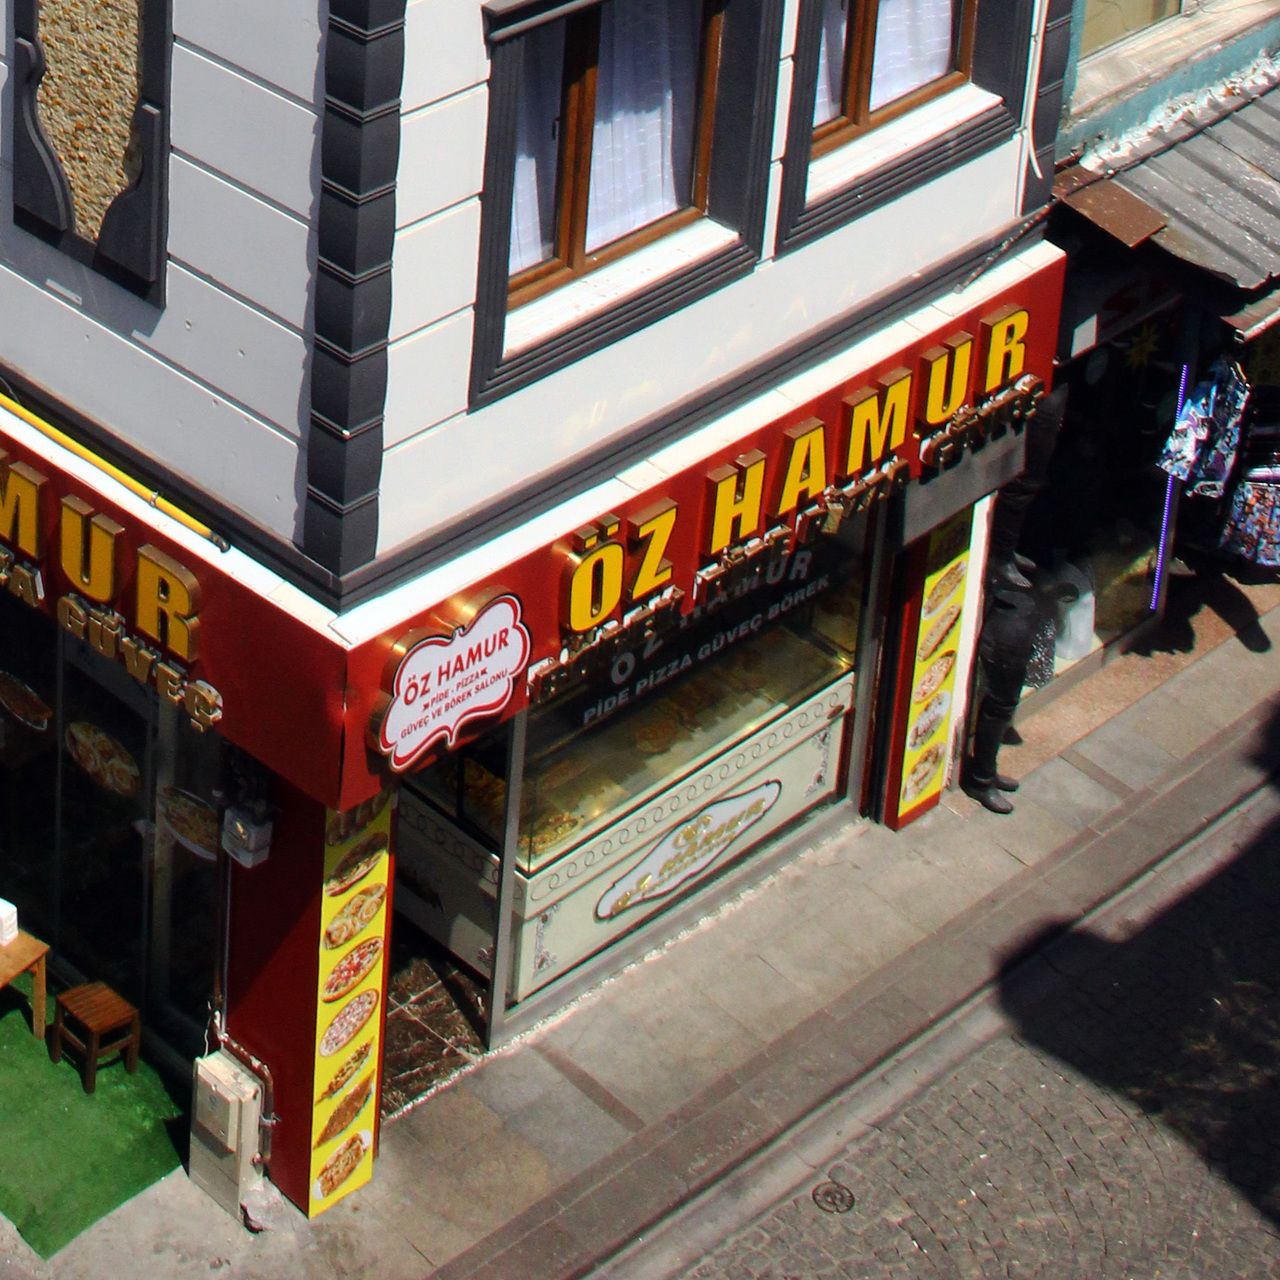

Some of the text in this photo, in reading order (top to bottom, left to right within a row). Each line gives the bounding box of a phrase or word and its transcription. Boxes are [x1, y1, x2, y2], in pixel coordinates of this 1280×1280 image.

[565, 304, 1030, 633] ÖZ HAMUR
[57, 593, 223, 732] GÜVEÇ
[403, 627, 509, 706] ÖZ HAMUR
[430, 689, 449, 707] PİDE
[456, 670, 481, 691] PİZZA
[583, 573, 830, 724] PİDE PİZZA GÜVEÇ BÖREK
[400, 668, 508, 739] GÜVEÇ VE BÖREK SALONU
